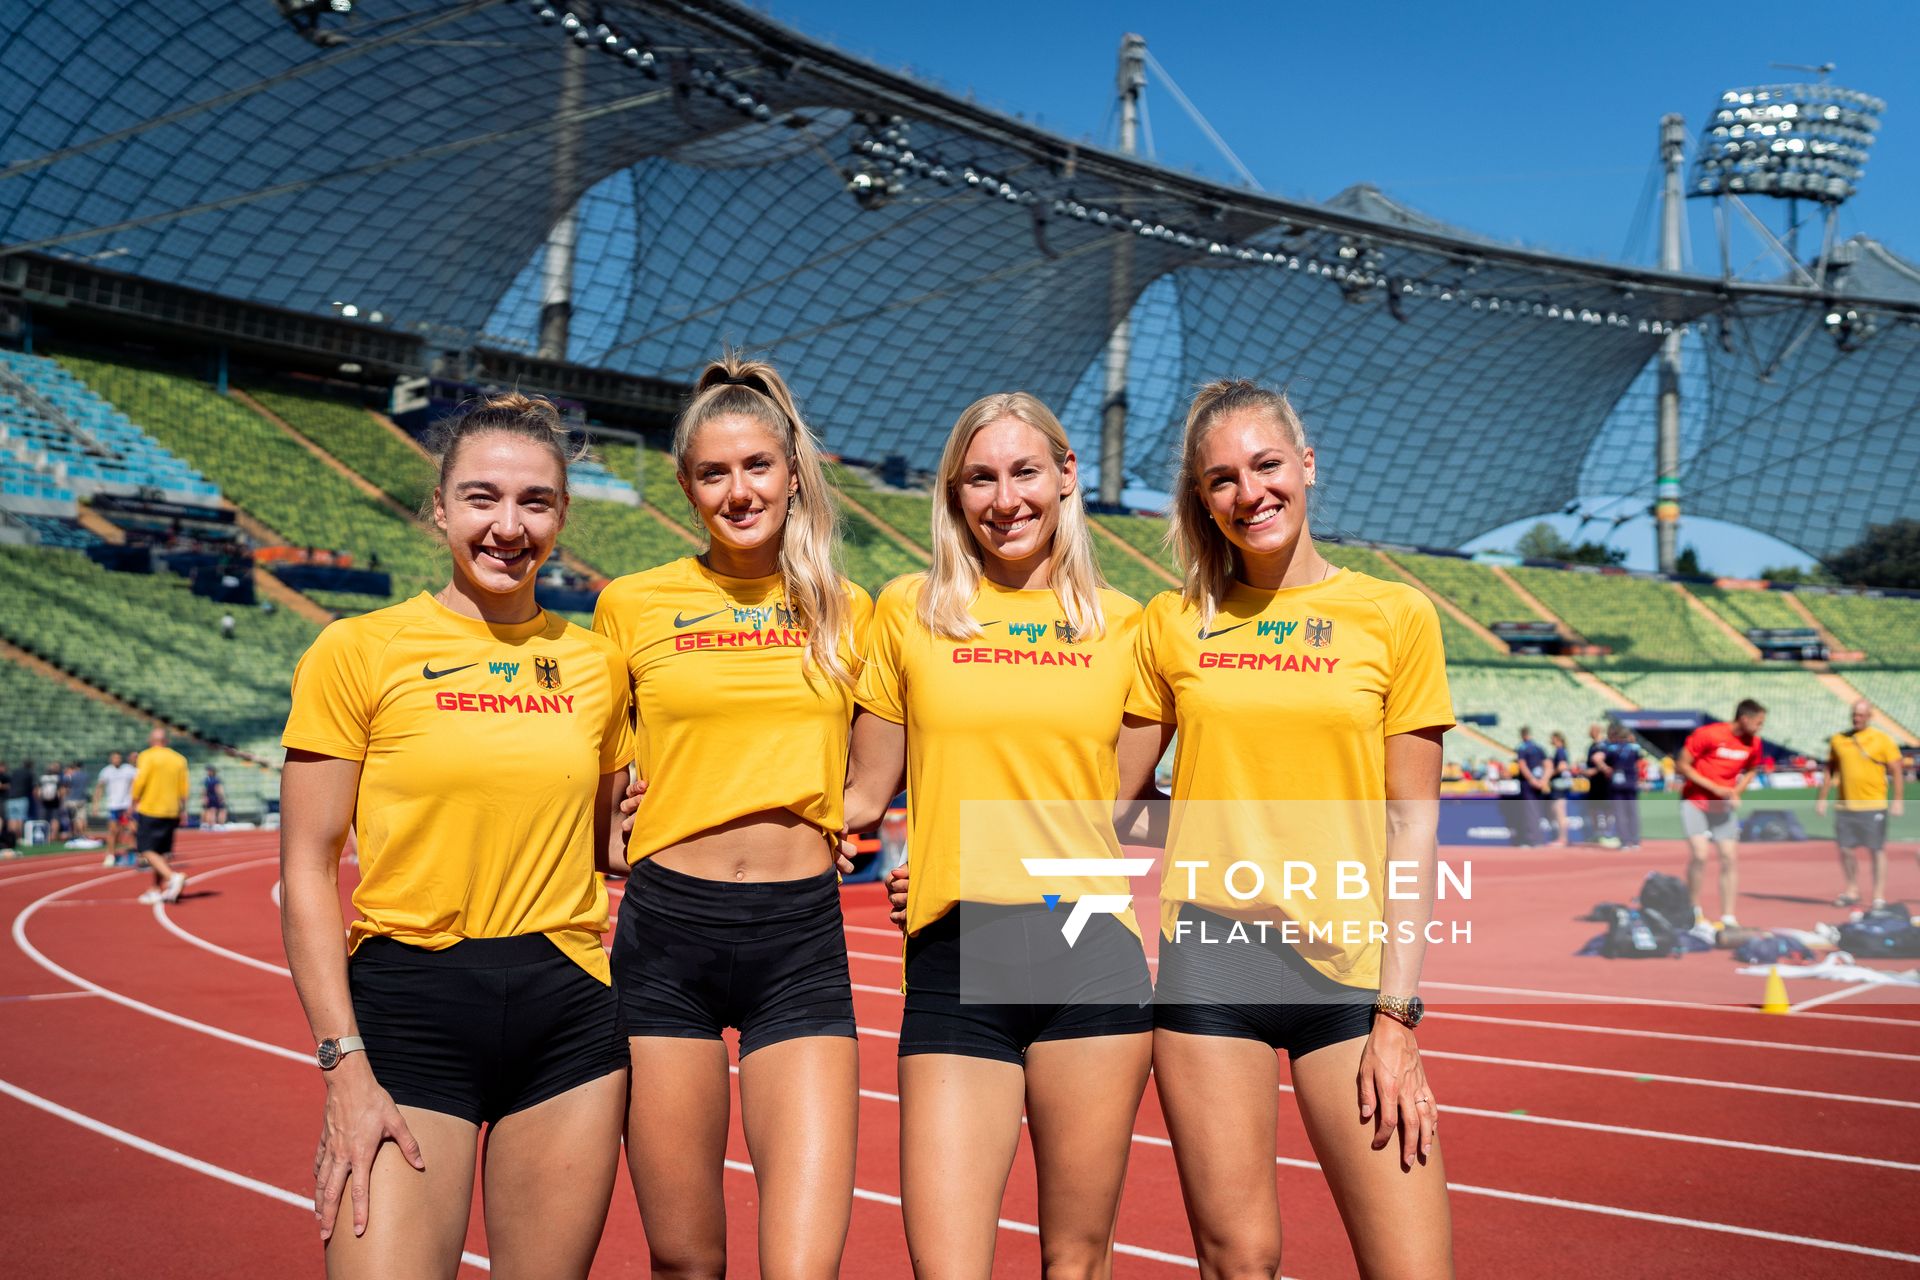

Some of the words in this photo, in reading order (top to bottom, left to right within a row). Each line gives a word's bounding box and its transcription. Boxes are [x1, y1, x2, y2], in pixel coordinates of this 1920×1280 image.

[953, 647, 1093, 668] GERMANY
[1199, 652, 1340, 674] GERMANY
[435, 691, 574, 714] GERMANY
